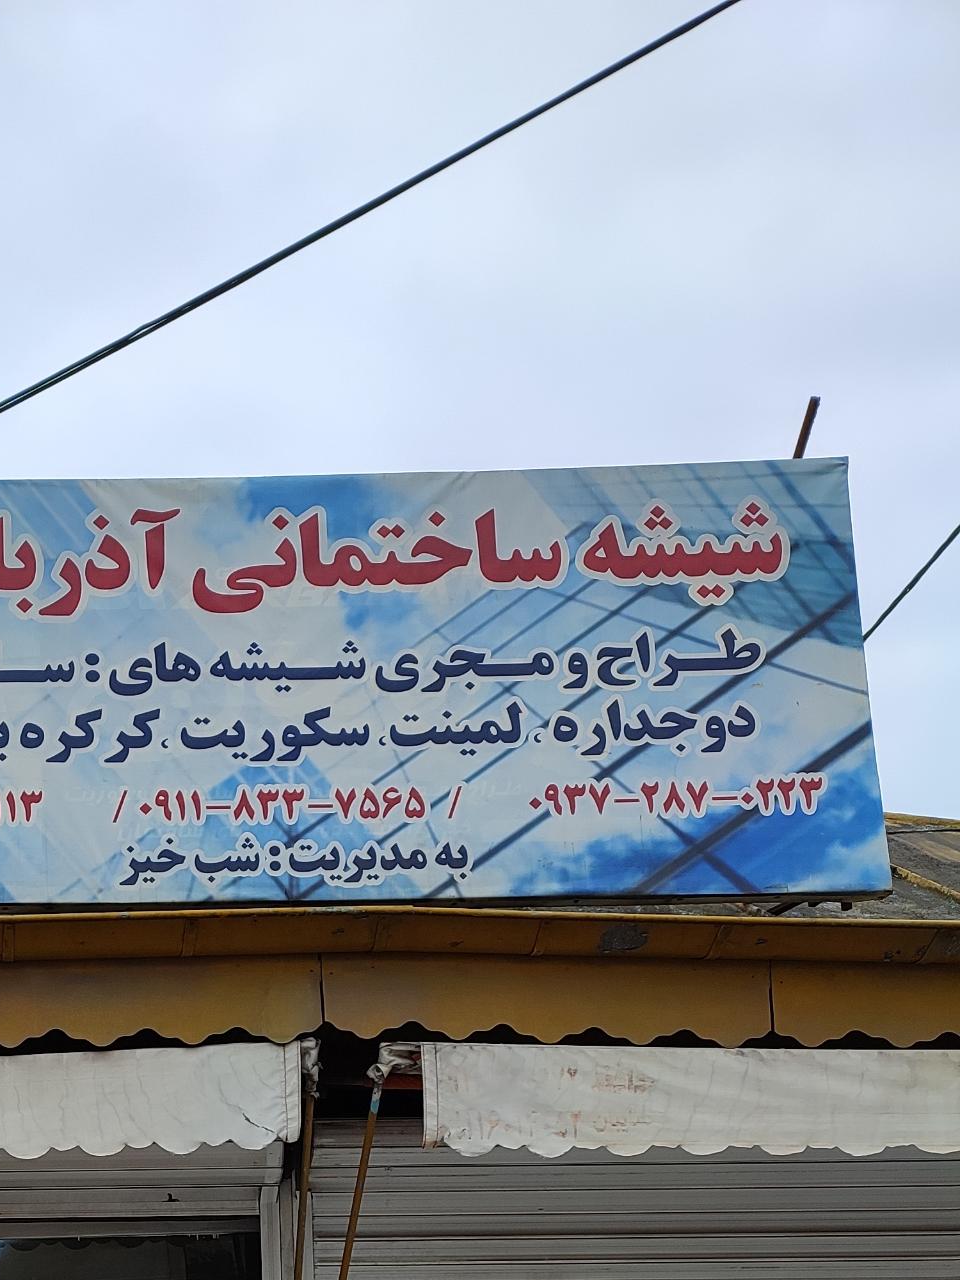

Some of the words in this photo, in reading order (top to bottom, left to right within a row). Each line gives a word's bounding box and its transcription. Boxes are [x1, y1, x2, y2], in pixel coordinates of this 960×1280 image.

[192, 508, 564, 614] ساختمانی
[581, 501, 784, 600] شیشه
[209, 641, 366, 693] شیشه
[375, 646, 556, 693] مجری
[562, 657, 588, 689] و
[596, 627, 762, 688] طراح
[119, 836, 187, 886] خیز
[193, 837, 261, 882] شب
[434, 842, 470, 878] به
